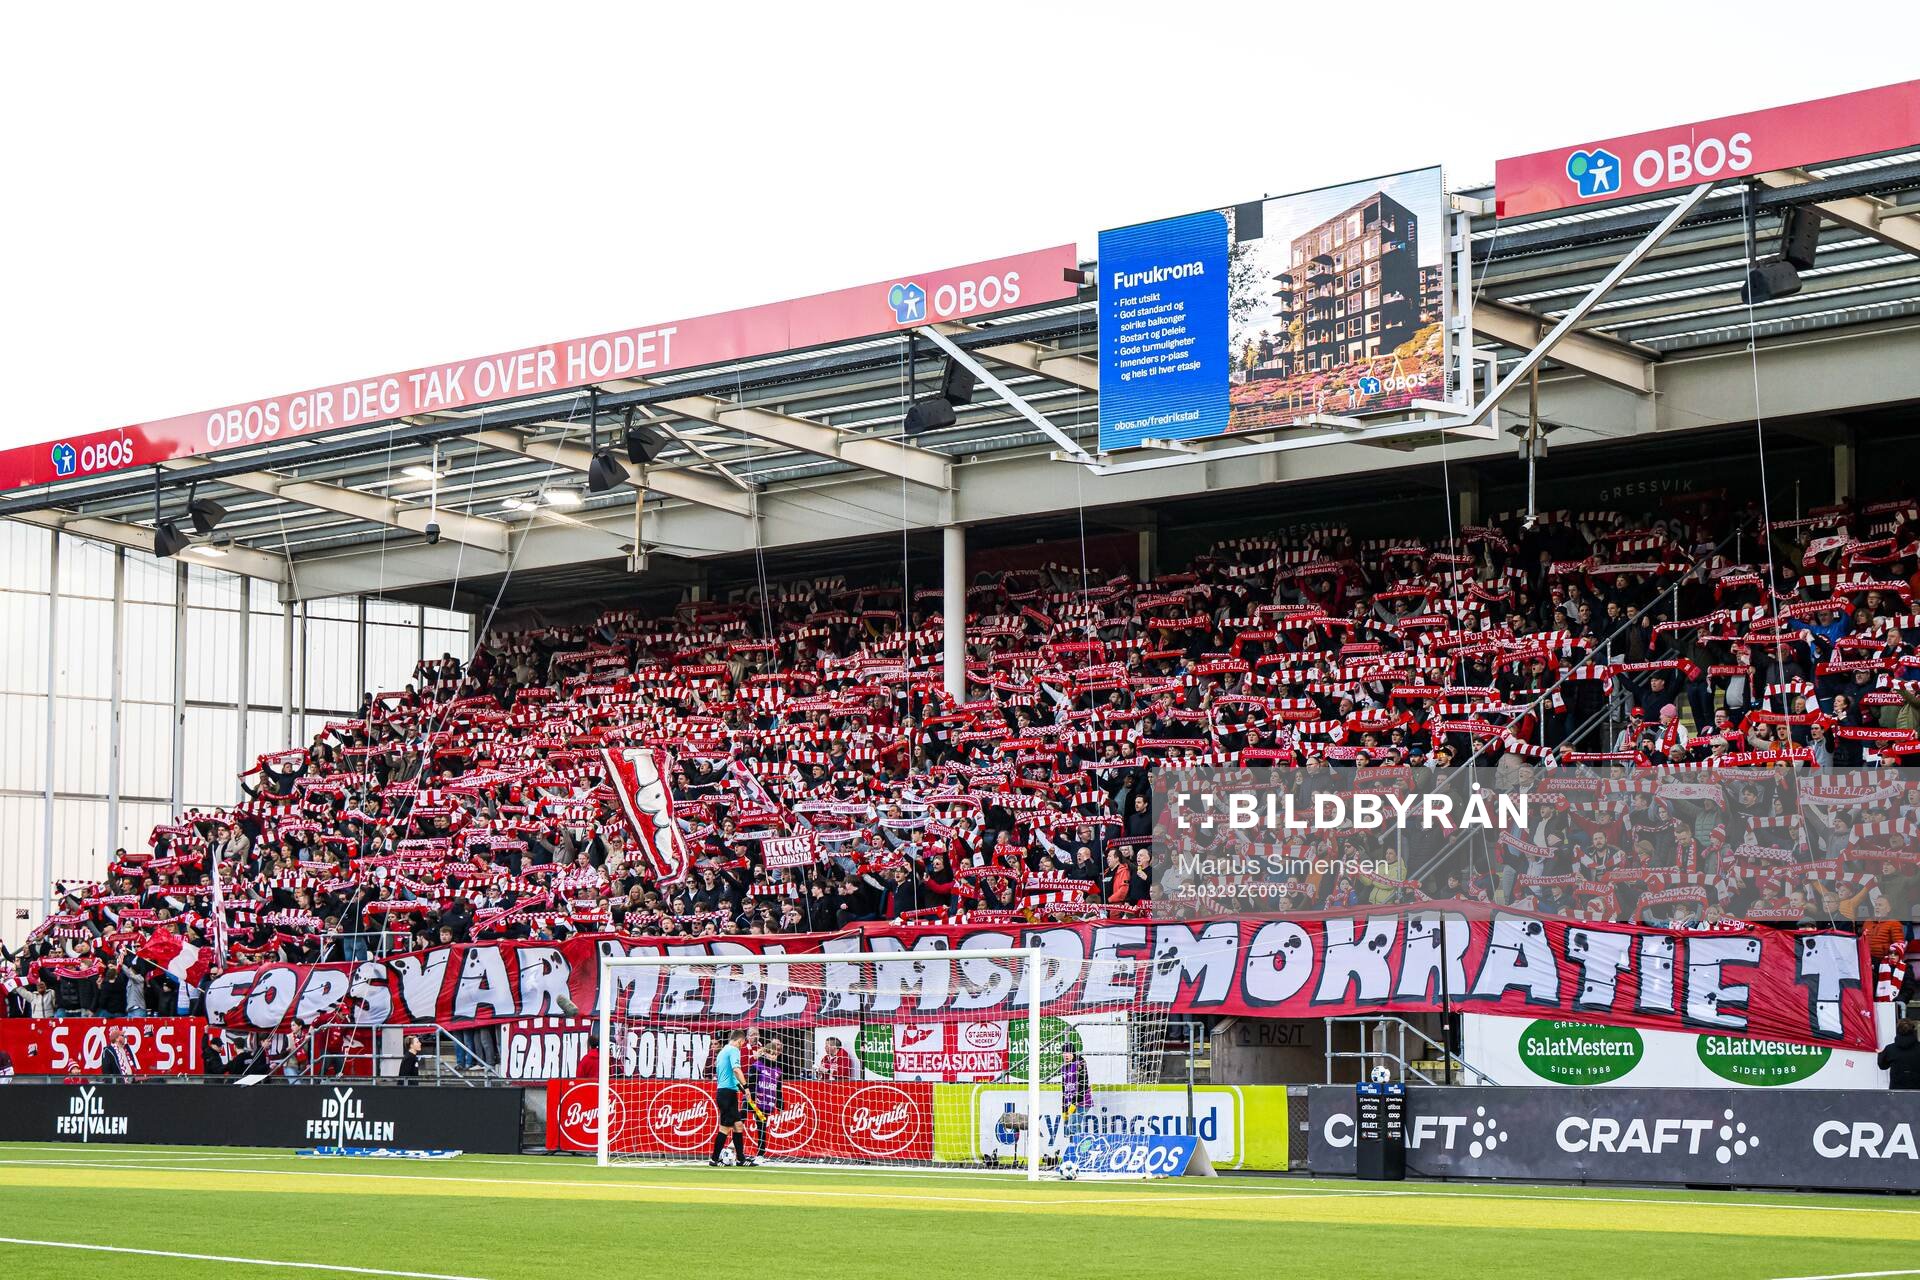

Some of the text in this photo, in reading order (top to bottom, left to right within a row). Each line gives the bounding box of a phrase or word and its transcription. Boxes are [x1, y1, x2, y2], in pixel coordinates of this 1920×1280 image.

[1632, 131, 1754, 189] OBOS
[1113, 260, 1205, 289] Furukrona
[934, 270, 1021, 320] OBOS
[1120, 293, 1161, 307] Flott utsikt
[1120, 302, 1184, 319] God standard og
[1120, 314, 1186, 331] solrike balkonger
[1120, 333, 1149, 344] Bostart
[1150, 331, 1161, 342] og
[1120, 336, 1196, 355] Gode turmuligheter
[1120, 350, 1189, 368] Innendørs p-plass
[1121, 372, 1131, 382] og
[1149, 366, 1157, 376] til
[1159, 364, 1176, 374] hver
[1177, 360, 1201, 374] etasje
[206, 327, 678, 446] OBOS GIR DEG TAK OVER HODET
[1384, 373, 1427, 391] OBOS
[1114, 410, 1200, 432] obos.no/fredrikstad
[81, 438, 133, 471] OBOS
[1157, 618, 1176, 626] ALLE
[1436, 630, 1501, 647] ALLE FOR EN
[1736, 748, 1807, 762] EN FOR ALLE
[1819, 786, 1838, 795] FOR
[1843, 785, 1872, 795] ALLE
[763, 838, 811, 855] ULTRAS
[206, 944, 573, 1028] FORSVAR
[1527, 1036, 1635, 1058] SalatMestern
[896, 1052, 1002, 1072] DELEGASJONEN
[1550, 1065, 1611, 1075] SIDEN 1988
[1732, 1065, 1797, 1075] SIDEN 1988
[654, 1100, 709, 1133] Brynild
[850, 1103, 910, 1134] Brynild
[1555, 1116, 1714, 1155] CRAFT
[1812, 1120, 1920, 1160] CRA
[1110, 1146, 1184, 1175] OBOS
